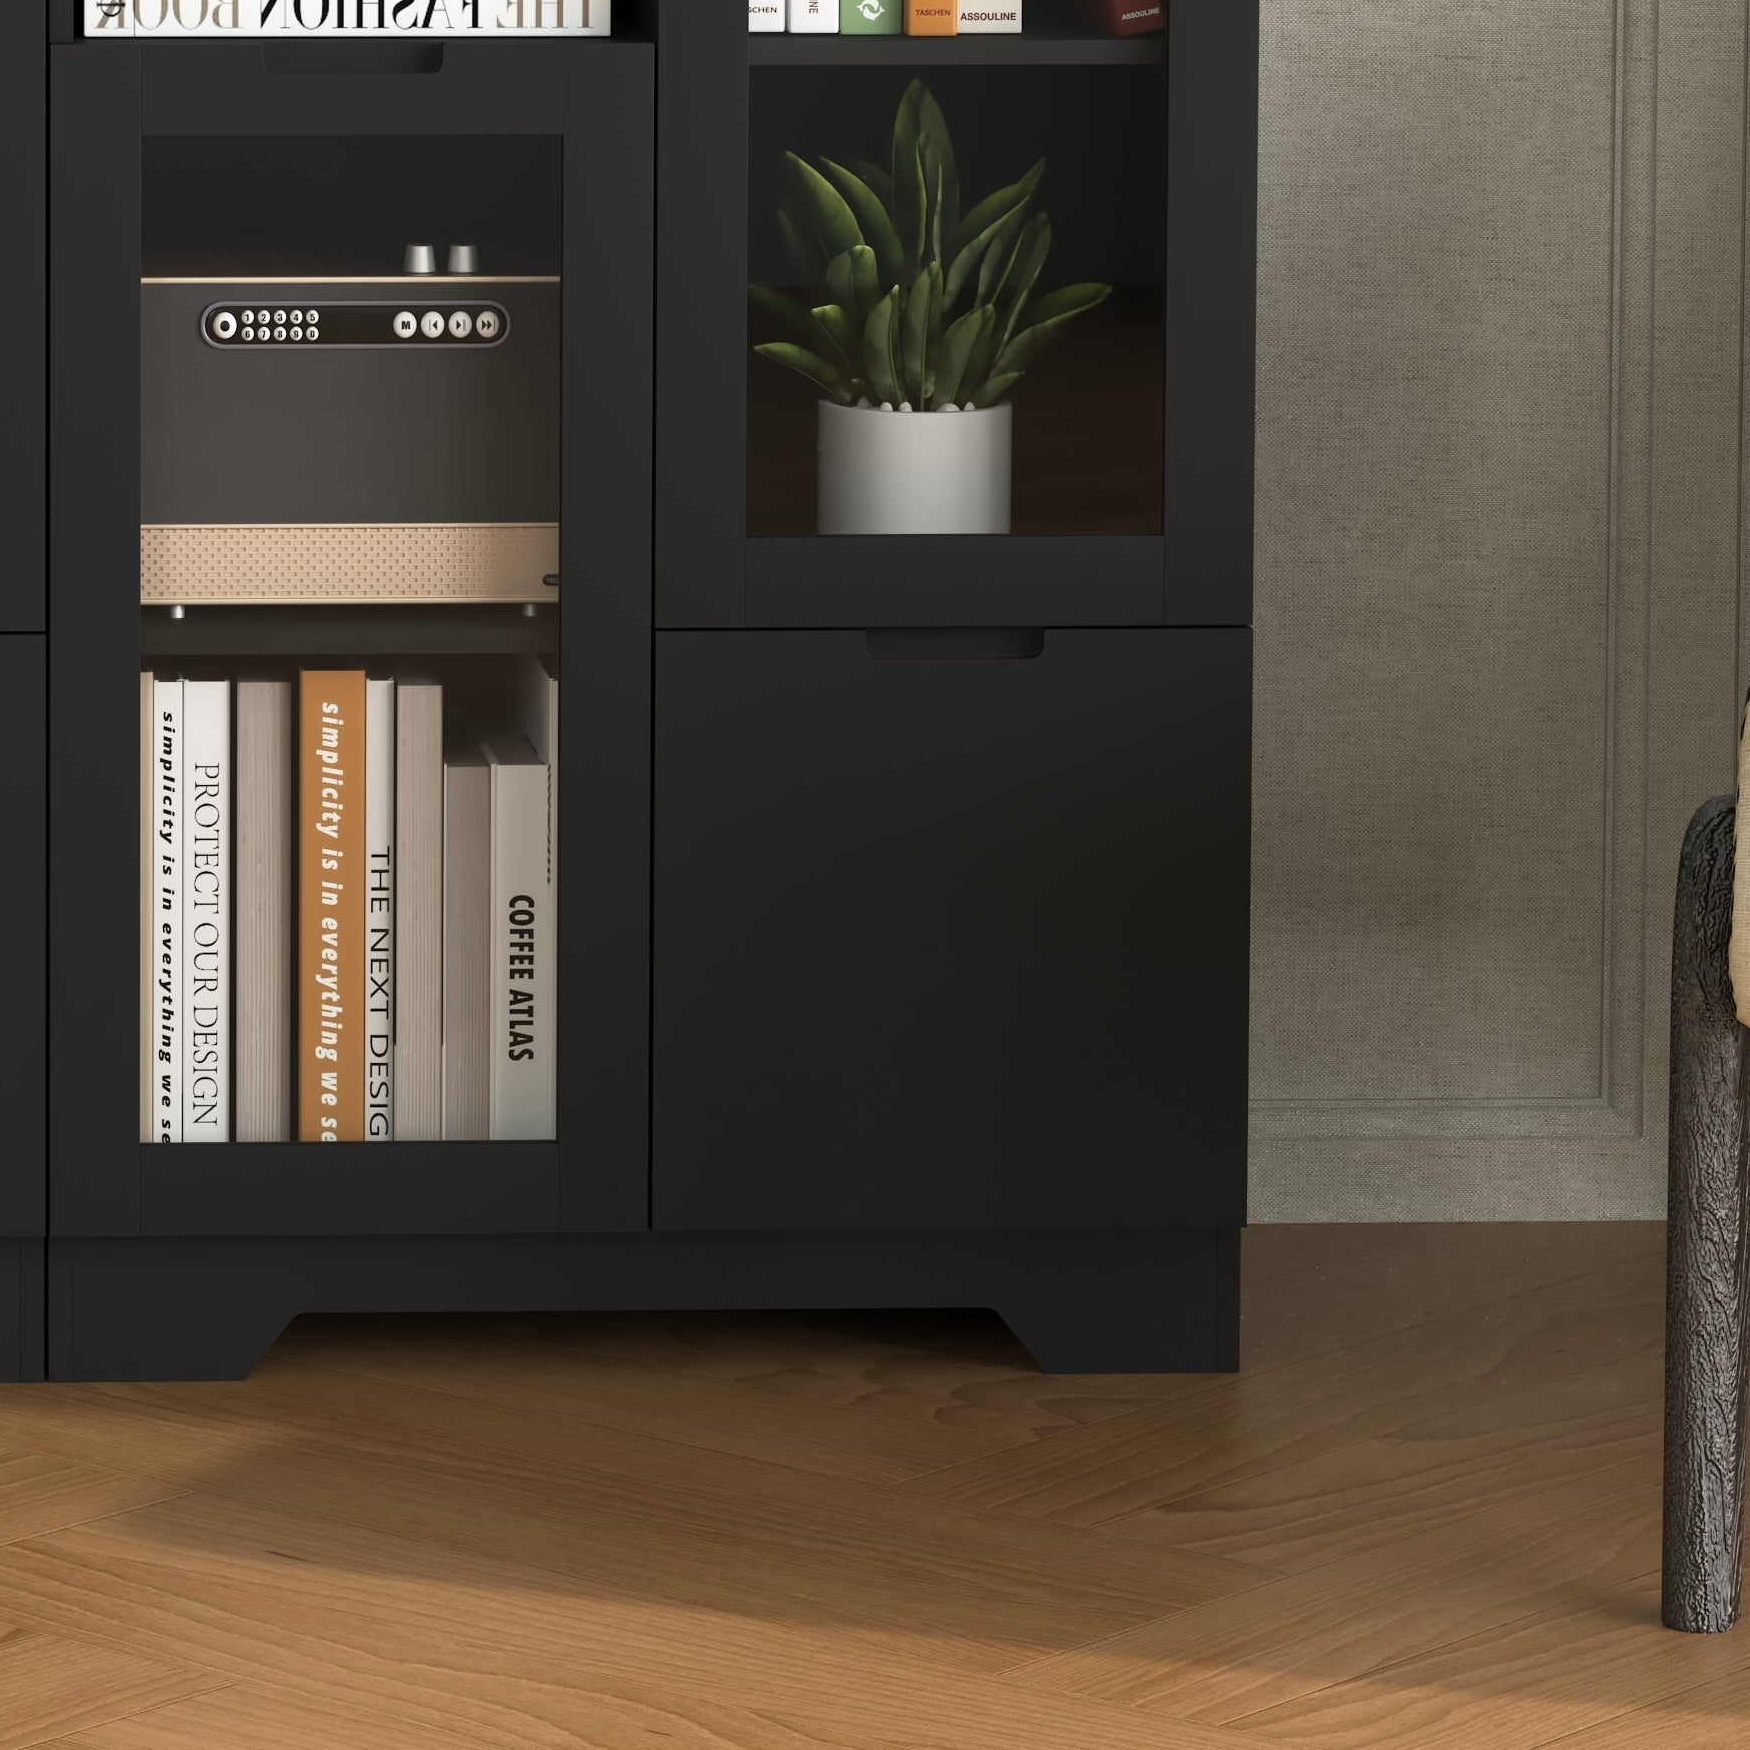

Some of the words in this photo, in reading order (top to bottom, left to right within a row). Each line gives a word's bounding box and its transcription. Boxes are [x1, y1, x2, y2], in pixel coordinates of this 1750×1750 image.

[915, 9, 950, 17] TASCHEN
[960, 12, 1016, 22] ASSOULINE
[1122, 7, 1160, 21] ASSOULINE
[401, 321, 411, 330] M
[160, 711, 175, 844] simplicity
[316, 701, 344, 839] simplicity
[162, 855, 175, 876] is
[194, 762, 220, 915] PROTECT
[321, 848, 344, 871] is
[162, 887, 175, 910] in
[321, 881, 344, 906] in
[370, 845, 390, 914] THE
[193, 922, 220, 997] OUR
[508, 894, 535, 981] COFFEE
[159, 922, 175, 1064] everything
[315, 916, 344, 1063] everything
[370, 928, 390, 1020] NEXT
[508, 989, 534, 1062] ATLAS
[162, 1074, 171, 1108] we
[192, 1006, 219, 1126] DESIGN
[321, 1072, 337, 1107] we
[369, 1034, 389, 1137] DESIG
[161, 1119, 171, 1143] se
